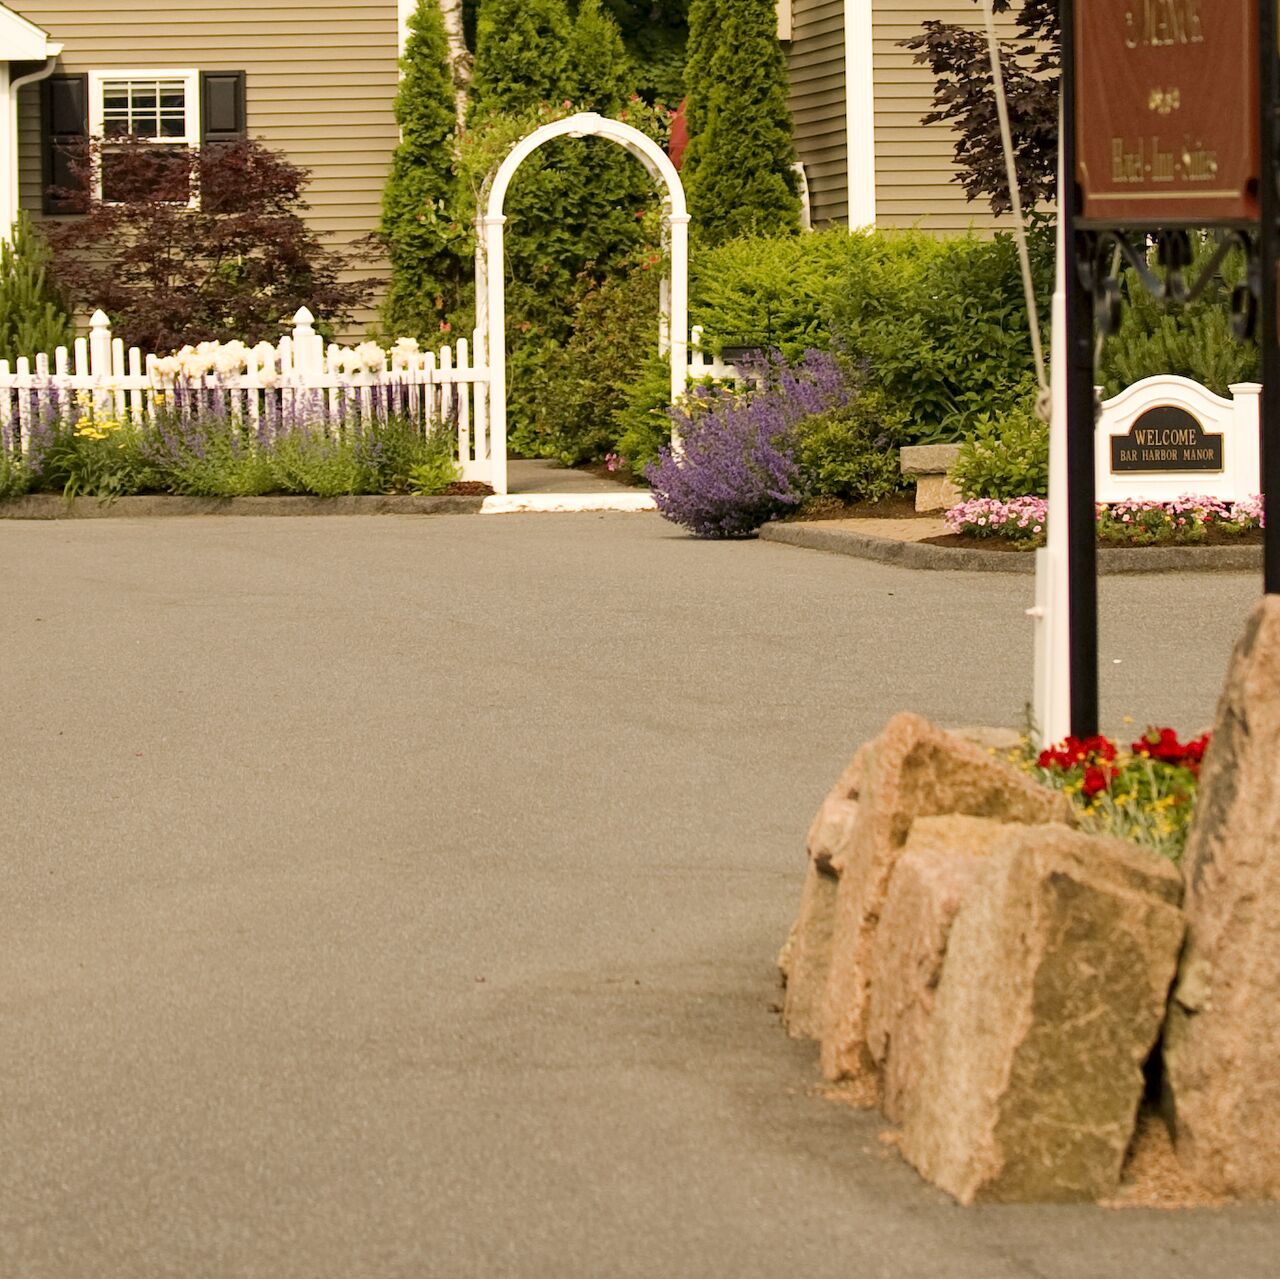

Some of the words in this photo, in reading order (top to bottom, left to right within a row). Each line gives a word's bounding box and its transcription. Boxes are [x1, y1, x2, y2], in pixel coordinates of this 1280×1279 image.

[1134, 428, 1197, 446] WELCOME
[1120, 449, 1138, 462] BAR
[1141, 448, 1178, 462] HARBOR
[1183, 448, 1215, 461] MANOR
